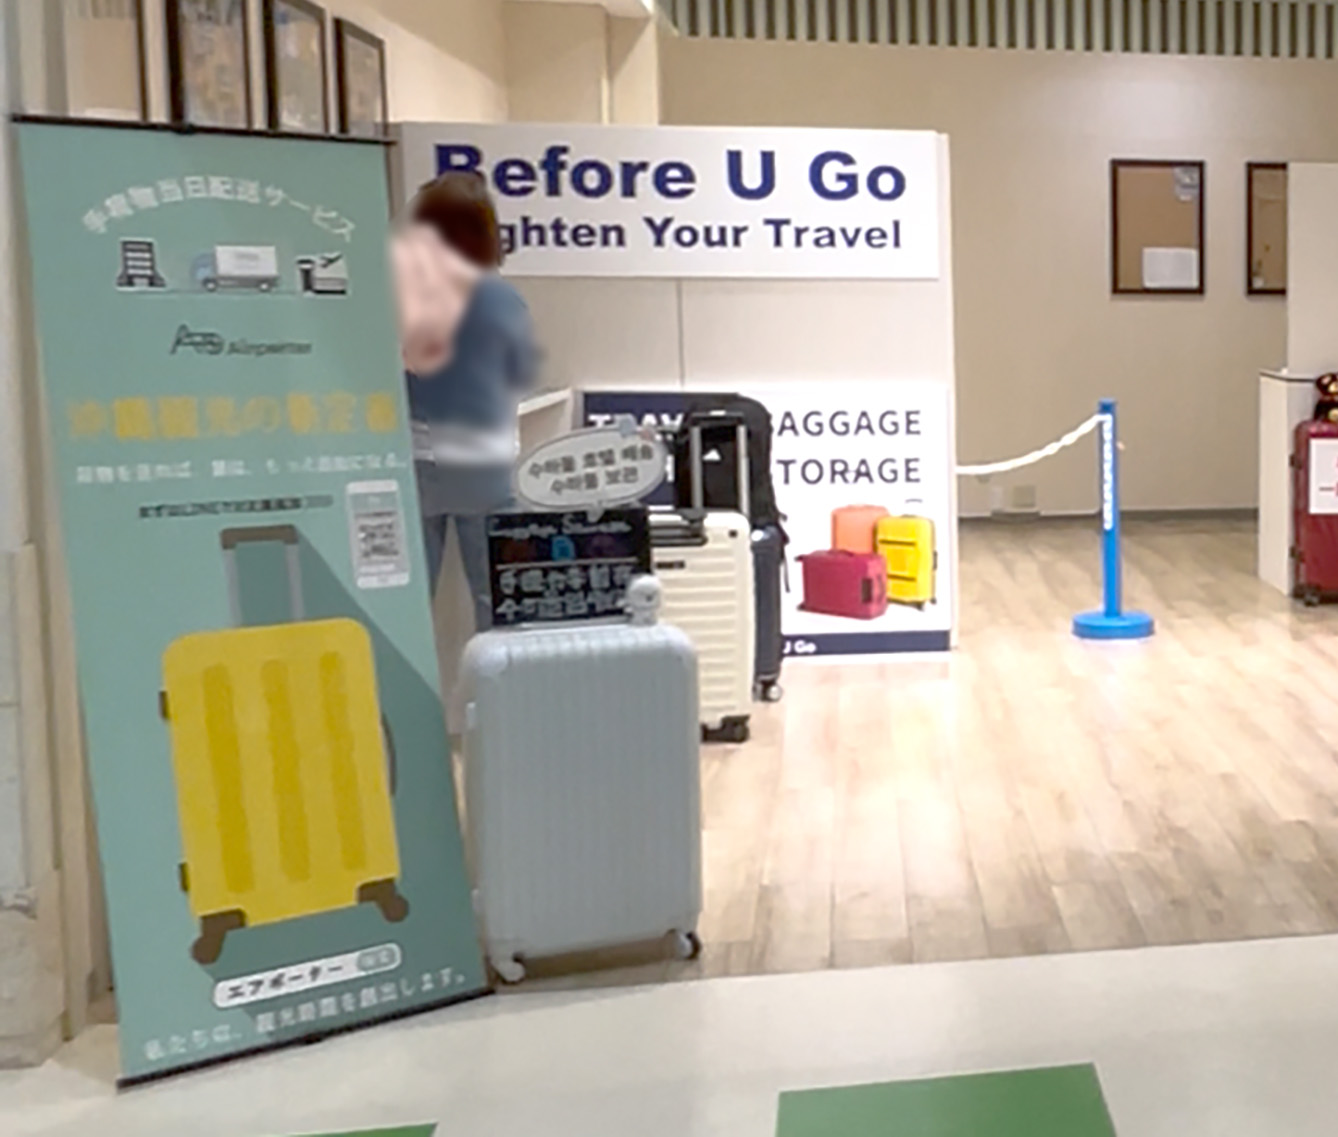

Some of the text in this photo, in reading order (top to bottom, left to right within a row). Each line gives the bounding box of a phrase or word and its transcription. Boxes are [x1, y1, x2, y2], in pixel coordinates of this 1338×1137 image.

[434, 144, 907, 202] Before U Go
[501, 216, 902, 253] ghten Your Travel
[777, 409, 921, 437] AGGAGE
[776, 457, 921, 485] TORAGE
